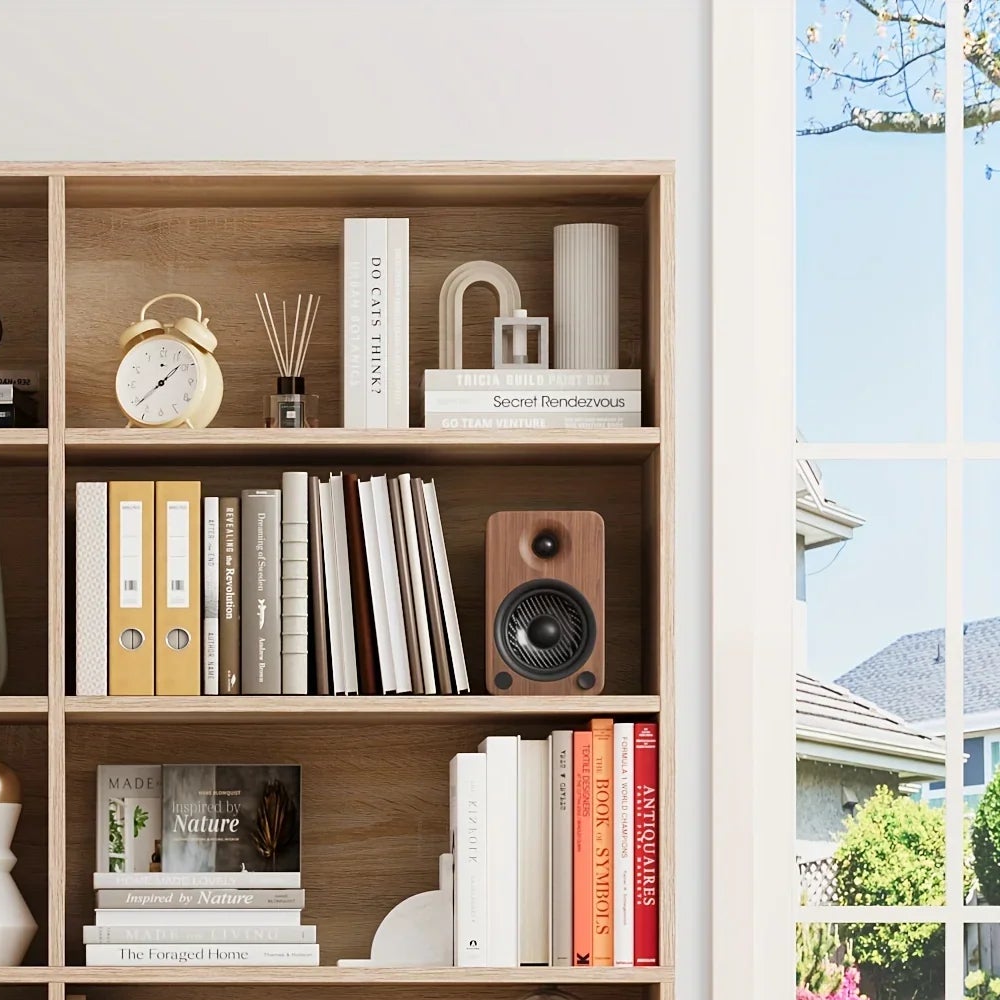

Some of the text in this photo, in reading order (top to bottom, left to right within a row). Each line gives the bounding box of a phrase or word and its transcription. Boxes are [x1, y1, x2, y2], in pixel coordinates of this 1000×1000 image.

[371, 257, 382, 395] DO CATS THINK?
[493, 395, 625, 408] Secret Rendezvous
[442, 417, 546, 429] GO TEAM VENTURE
[225, 507, 234, 553] REVEALING
[255, 512, 266, 551] Dreaming
[257, 551, 266, 561] of
[257, 561, 266, 592] Sweden
[225, 567, 235, 619] Revolution
[108, 777, 154, 790] MADE
[582, 743, 591, 817] TEXTILE DESIGNERS
[172, 801, 241, 815] Inspired by
[596, 778, 609, 828] BOOK
[172, 814, 240, 833] Nature
[641, 784, 656, 906] ANTIQUAIRES
[125, 892, 173, 905] Inspired
[179, 893, 193, 905] by
[198, 890, 254, 904] Nature
[596, 847, 609, 935] SYMBOLS
[119, 947, 249, 963] The Foraged Home
